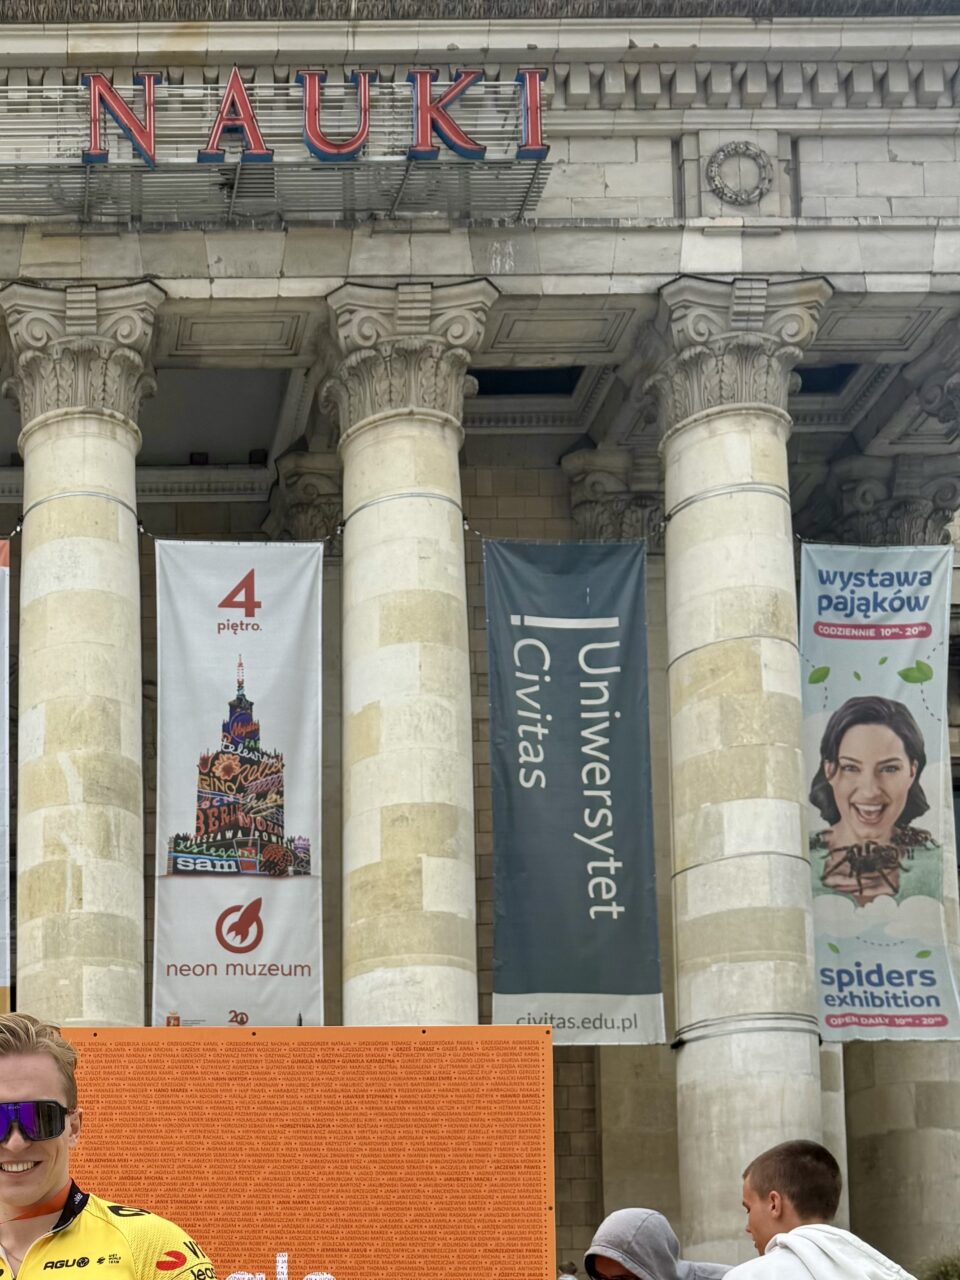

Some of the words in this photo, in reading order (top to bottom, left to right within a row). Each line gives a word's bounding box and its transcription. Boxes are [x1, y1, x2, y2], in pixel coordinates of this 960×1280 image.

[81, 64, 549, 168] NAUKI
[818, 569, 932, 591] wystawa
[217, 568, 262, 617] 4
[817, 589, 930, 618] pająków
[217, 618, 263, 635] piętro.
[818, 625, 876, 637] CODZIENNIE
[513, 638, 551, 789] Civitas
[573, 640, 626, 920] Uniwersytet
[176, 858, 238, 872] sam
[167, 963, 217, 977] neon
[225, 963, 311, 977] muzeum
[820, 961, 937, 993] spiders
[824, 990, 940, 1008] exhibition
[516, 1012, 638, 1032] civitas.edu.pl
[830, 1016, 859, 1025] OPEN
[860, 1016, 889, 1025] DAILY
